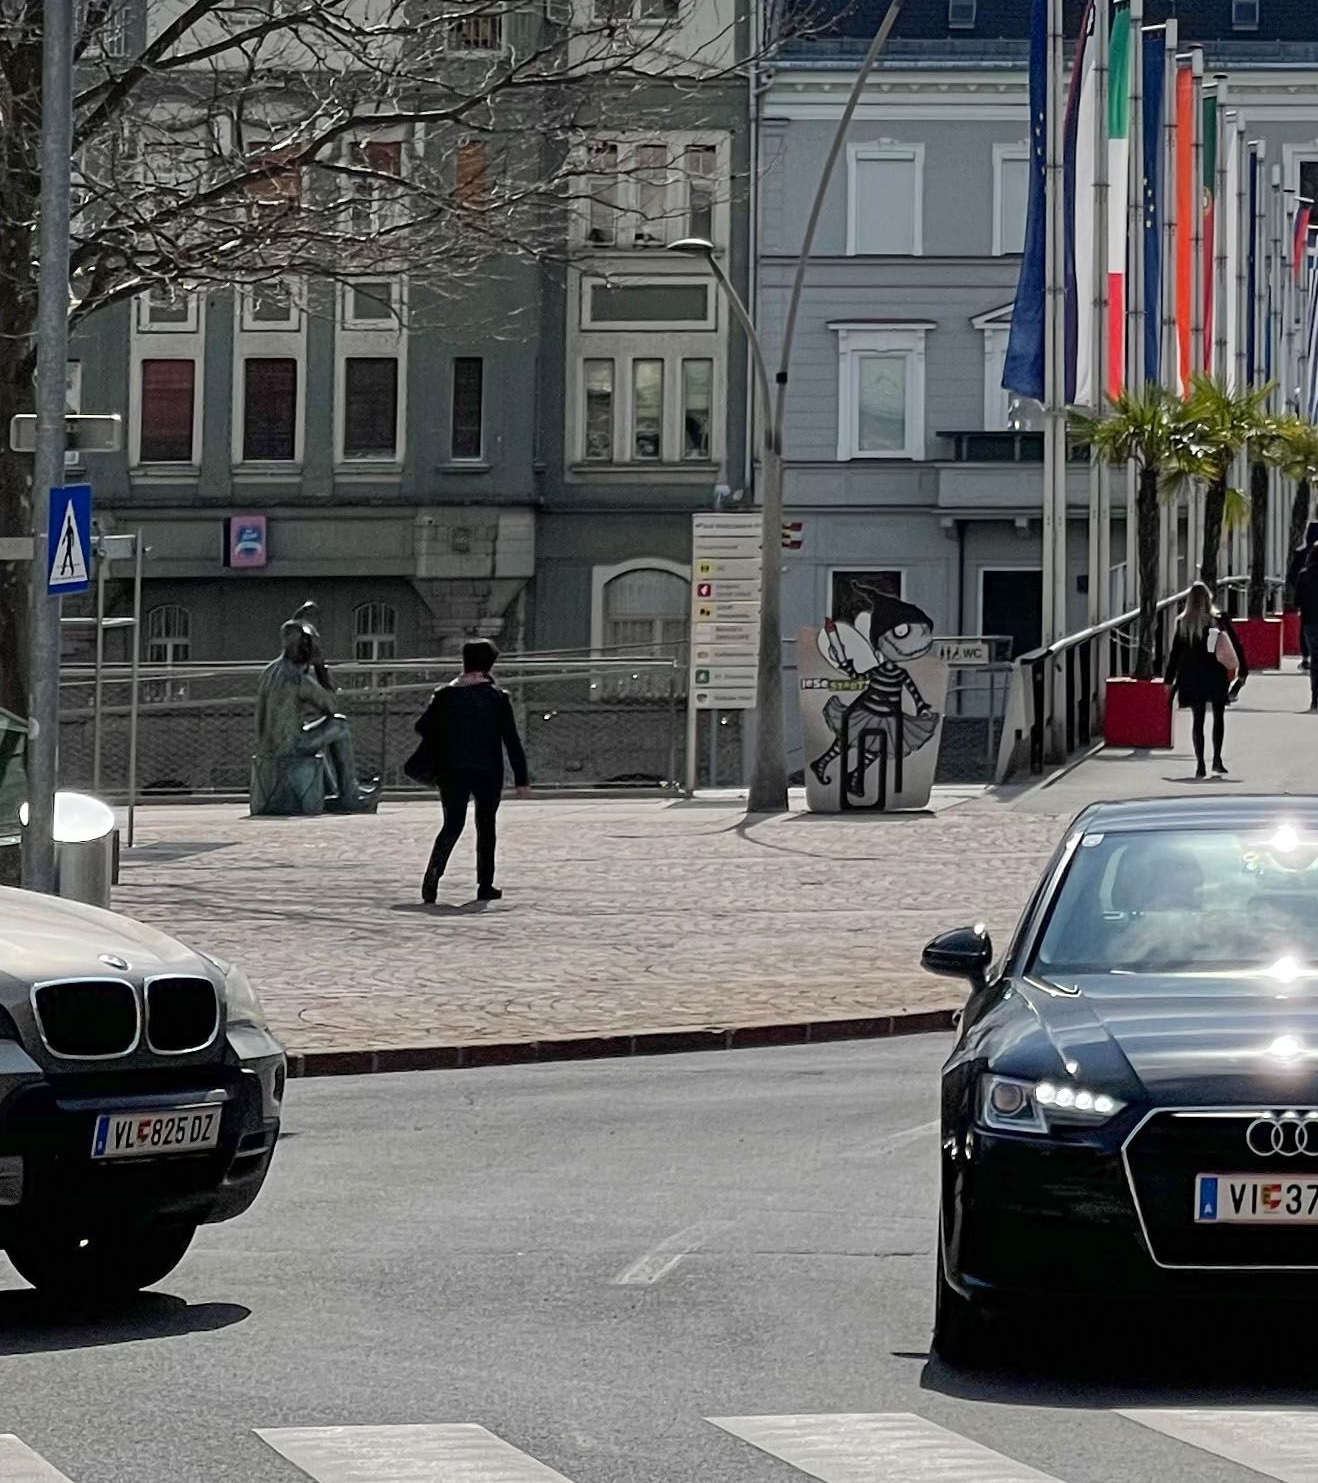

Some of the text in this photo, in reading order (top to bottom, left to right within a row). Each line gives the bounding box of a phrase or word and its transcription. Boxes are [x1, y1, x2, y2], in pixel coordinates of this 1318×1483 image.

[963, 648, 983, 659] WC
[115, 1114, 213, 1149] VL 825 DZ
[1230, 1183, 1258, 1215] VI
